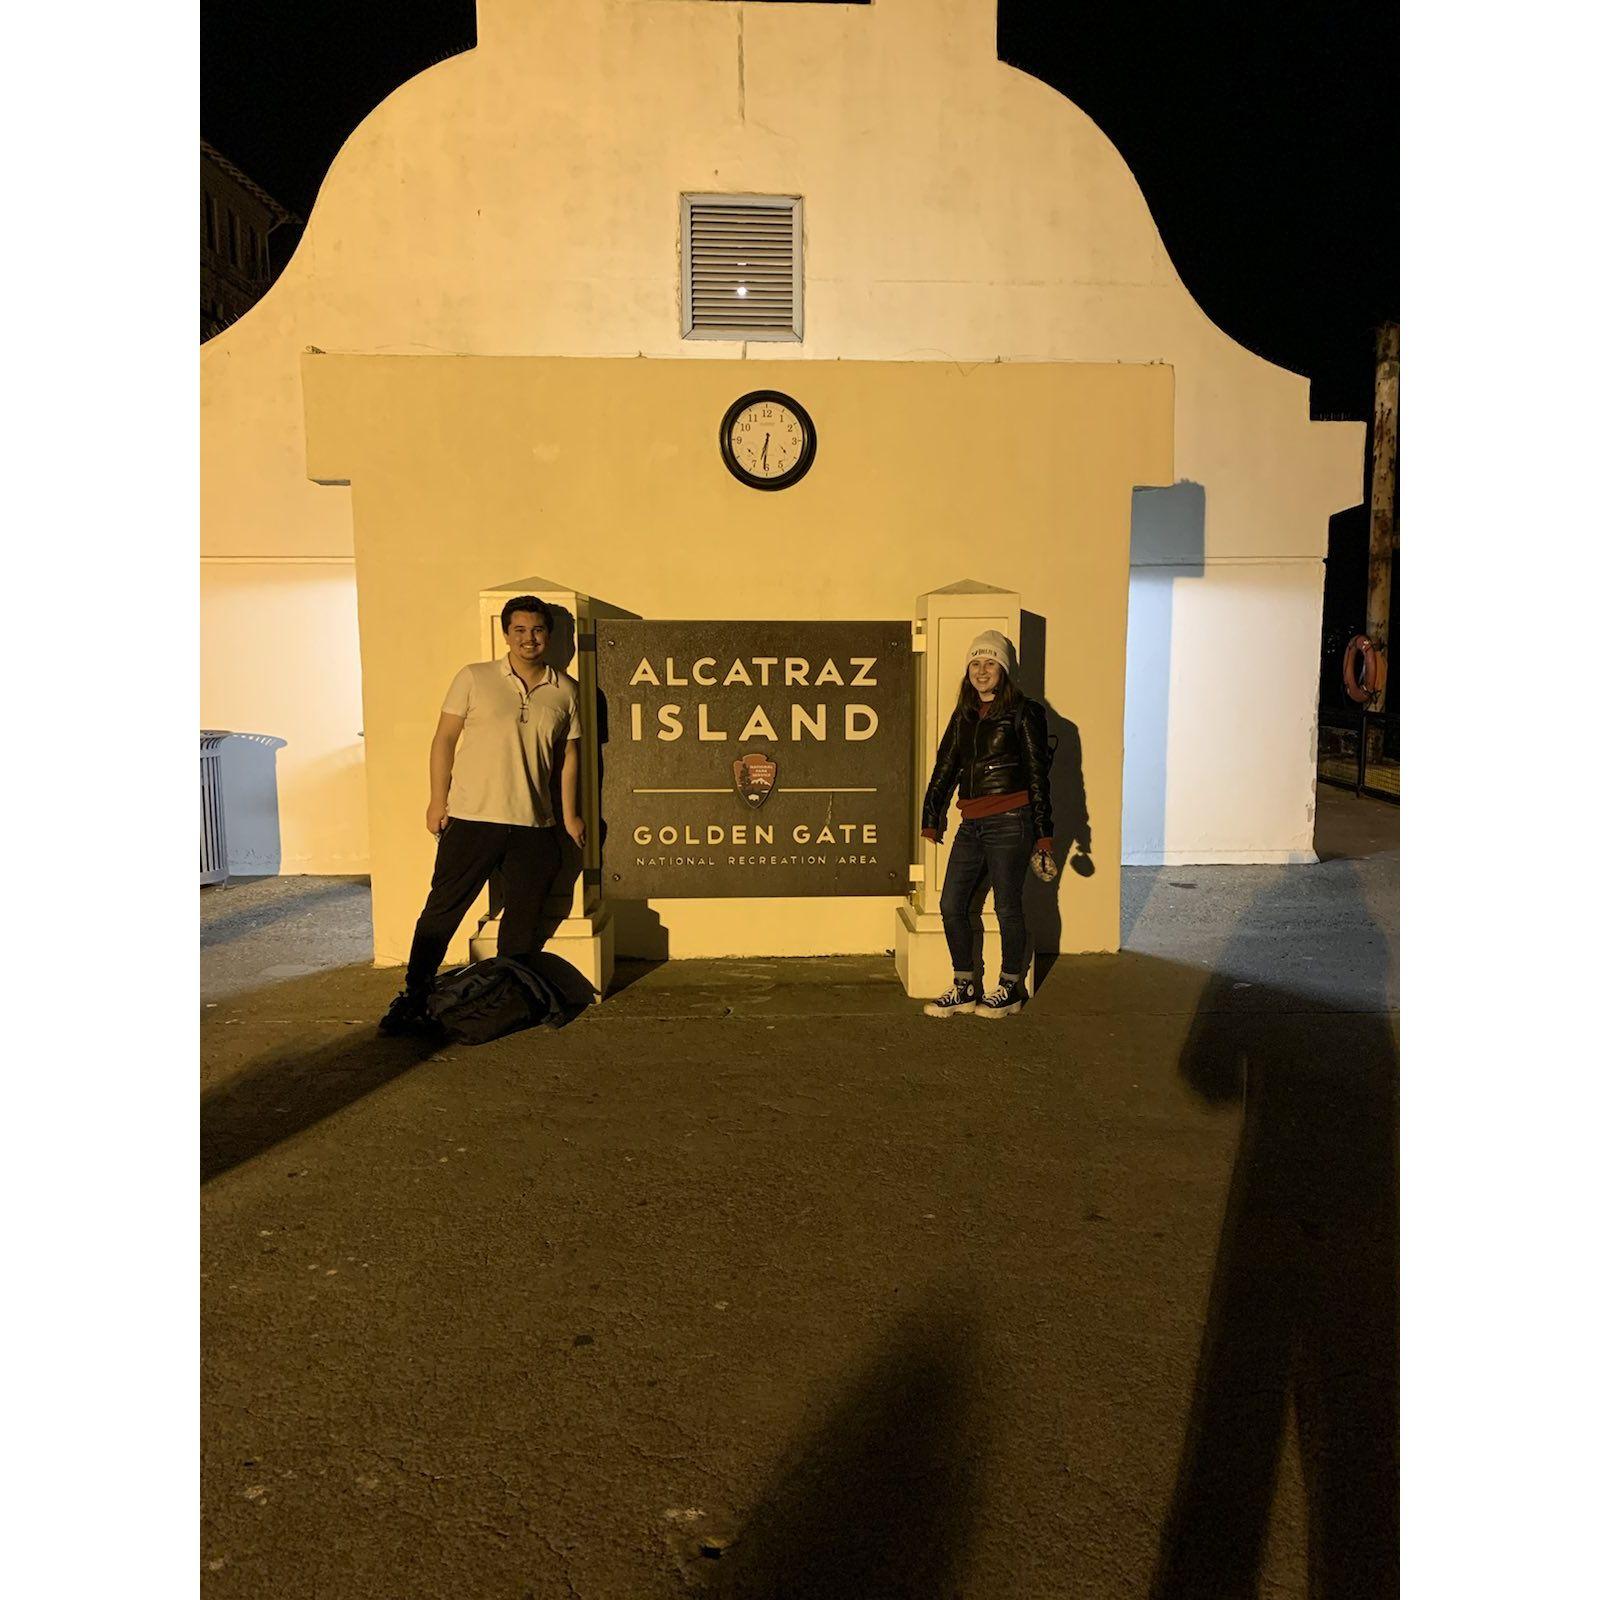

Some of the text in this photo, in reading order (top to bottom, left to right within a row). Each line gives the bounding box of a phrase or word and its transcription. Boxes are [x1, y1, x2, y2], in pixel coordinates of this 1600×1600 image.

[762, 409, 772, 418] 12
[748, 414, 758, 422] 11
[780, 414, 784, 422] 1
[740, 424, 751, 432] 10
[787, 424, 793, 432] 2
[792, 437, 797, 445] 3
[751, 460, 757, 468] 7
[777, 460, 783, 468] 5
[629, 657, 877, 686] ALCATRAZ
[631, 703, 879, 741] ISLAND
[633, 824, 877, 845] GOLDEN GATE
[636, 856, 877, 866] NATIONAL RECREATION AREA
